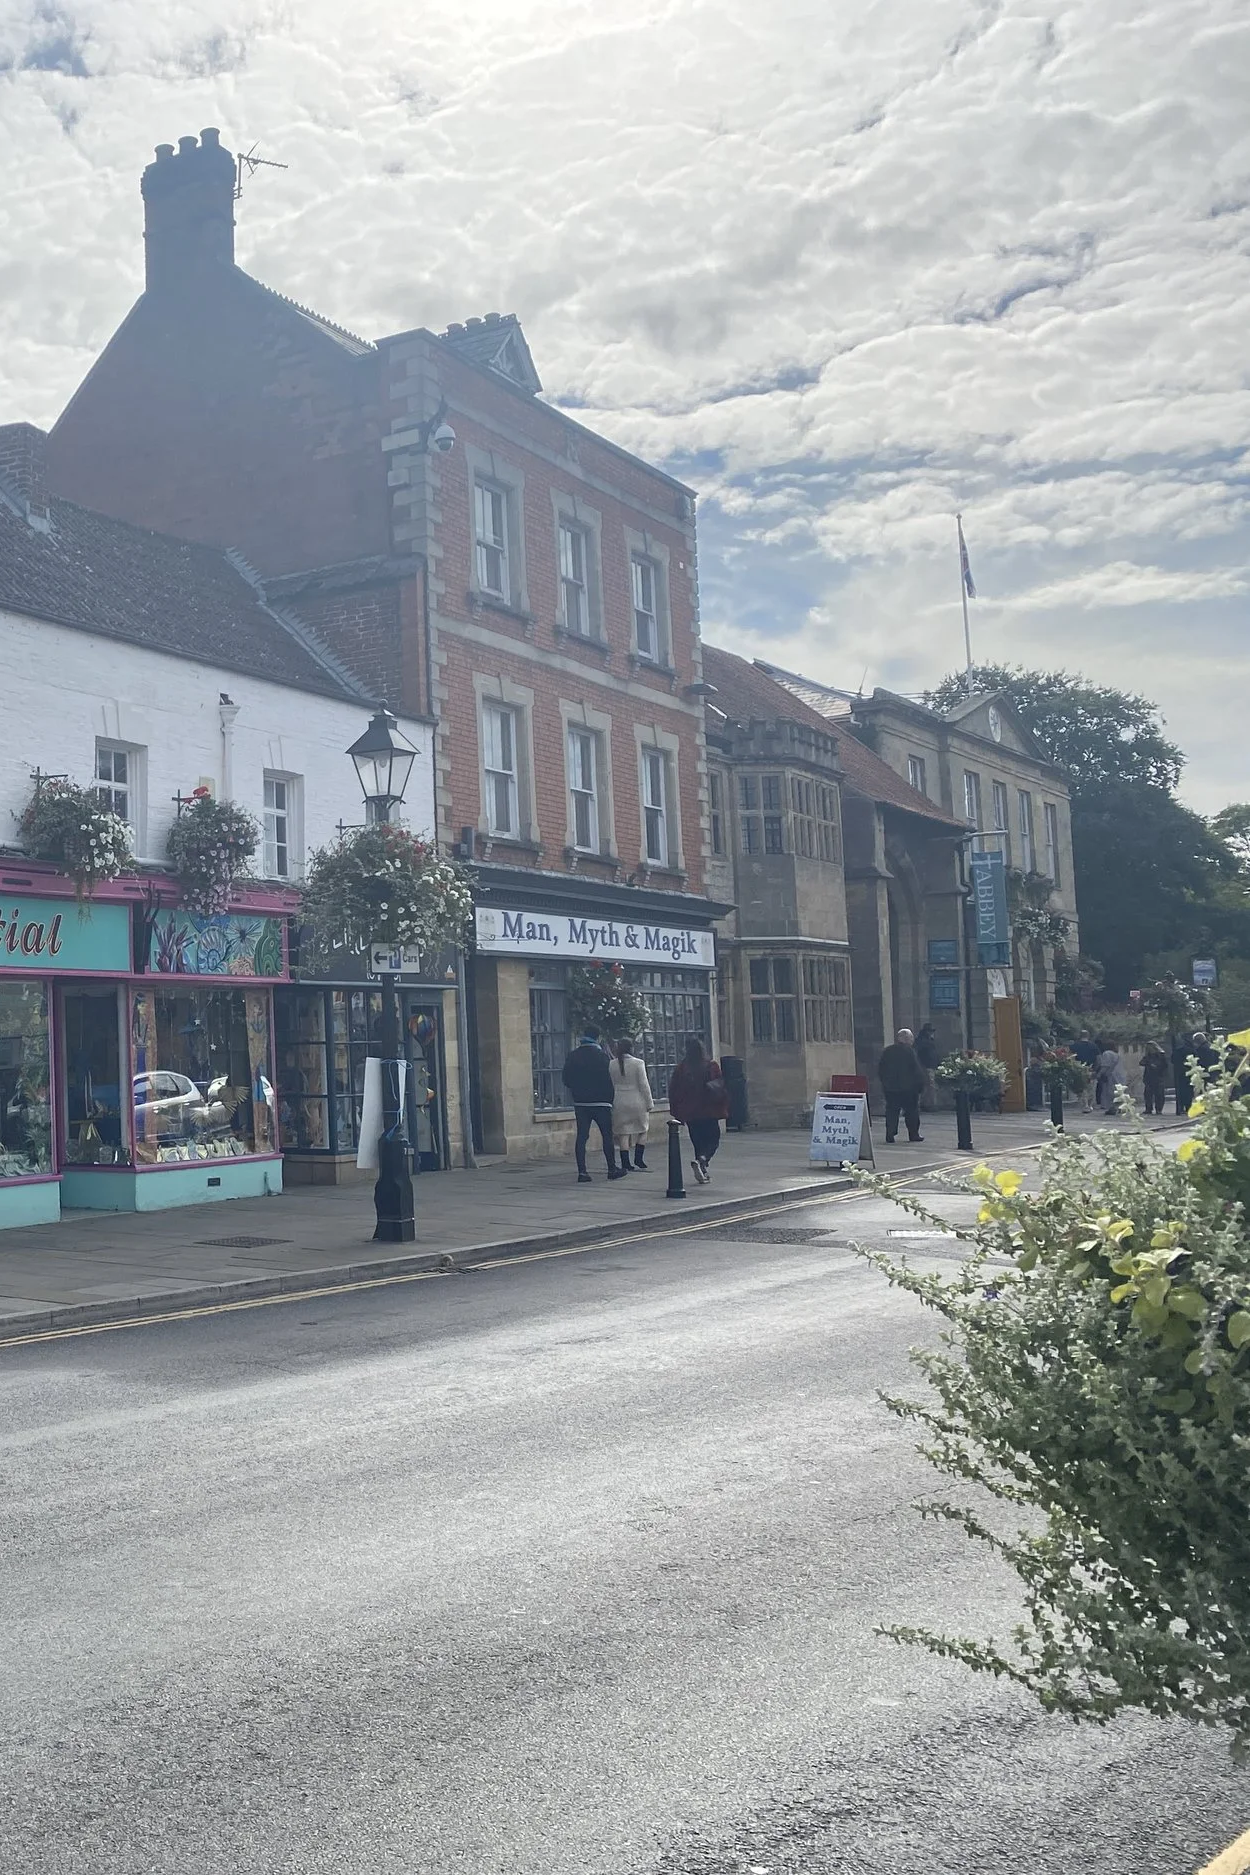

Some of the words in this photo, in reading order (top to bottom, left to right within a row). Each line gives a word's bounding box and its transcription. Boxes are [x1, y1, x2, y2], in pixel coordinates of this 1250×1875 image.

[976, 868, 997, 938] ABBEY
[501, 911, 559, 946] Man,
[567, 918, 620, 953] Myth
[624, 925, 640, 949] &
[643, 926, 698, 961] Magik
[402, 953, 418, 963] Cars
[824, 1115, 851, 1125] Man,
[821, 1125, 849, 1136] Myth
[812, 1135, 822, 1144] &
[826, 1135, 859, 1147] Magik
